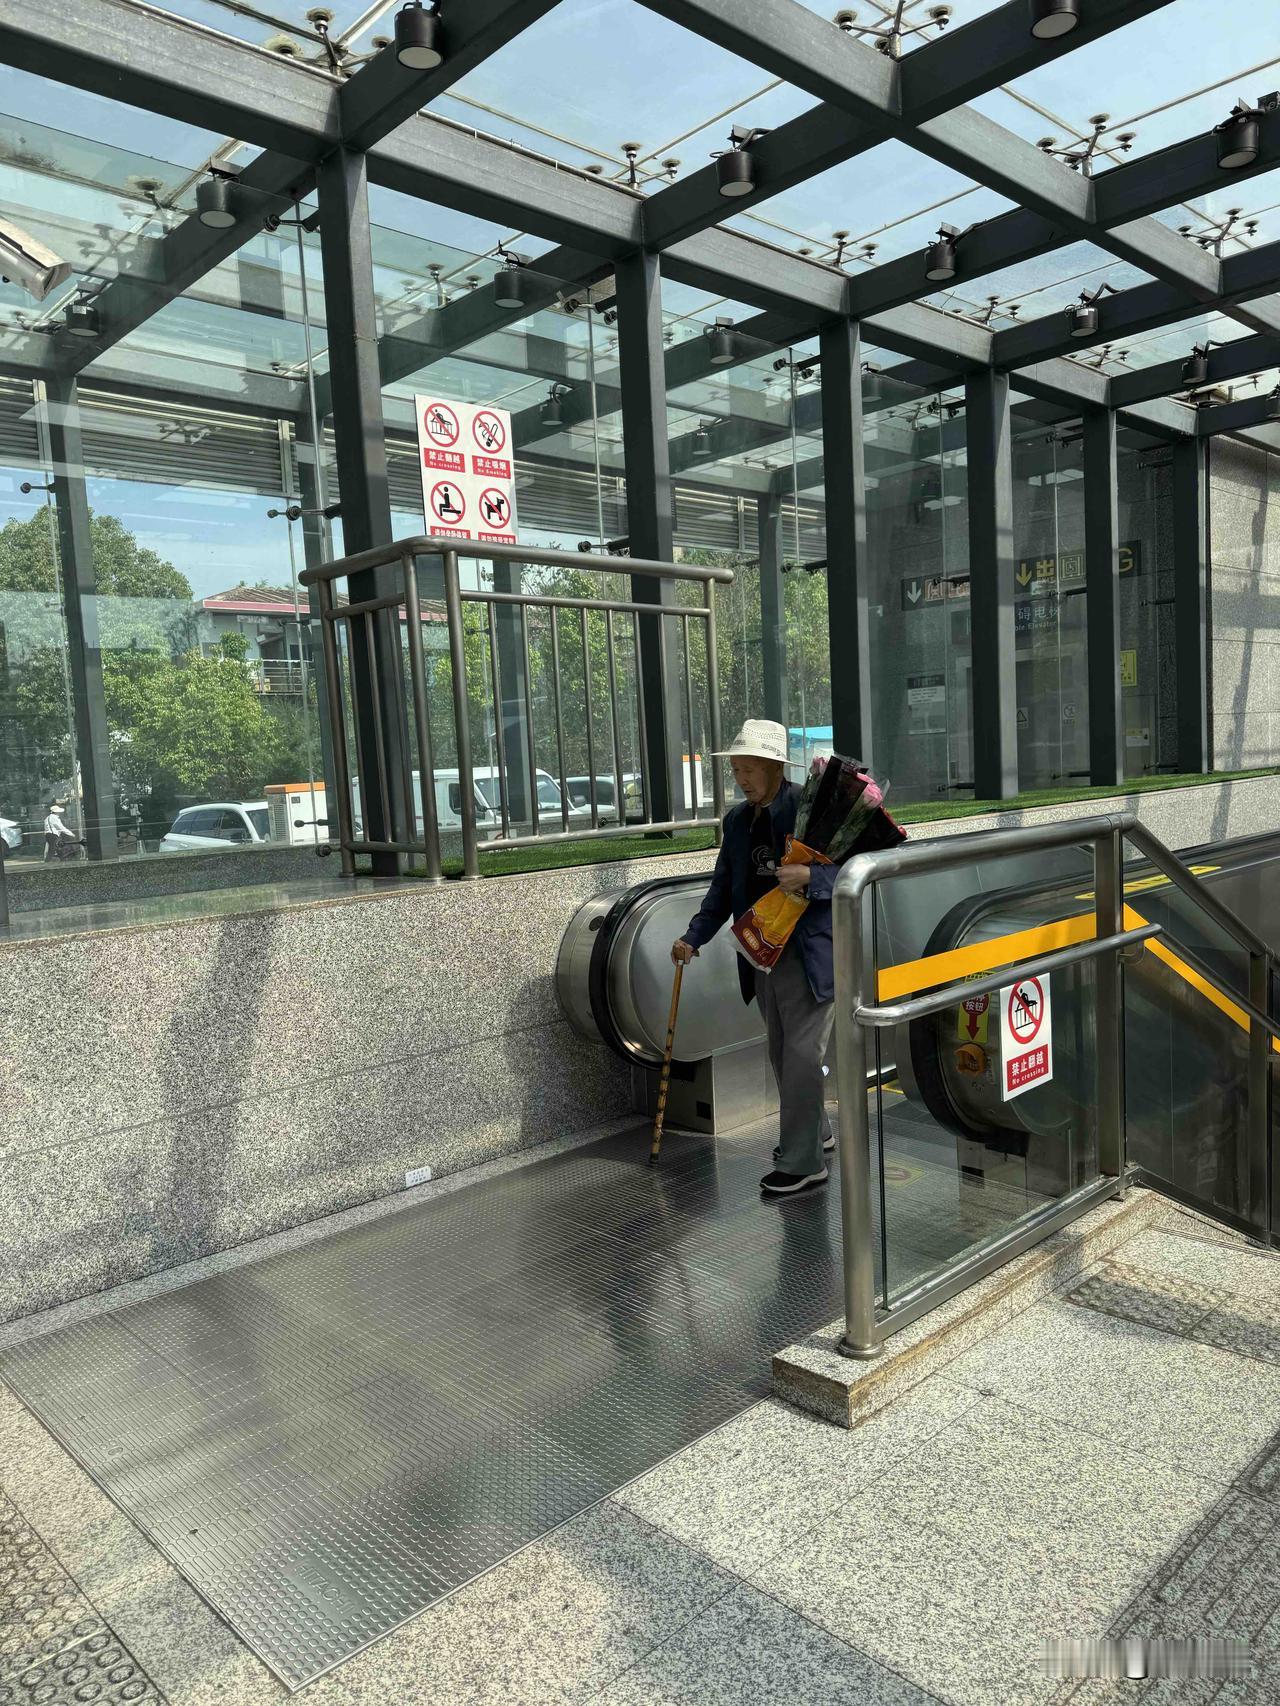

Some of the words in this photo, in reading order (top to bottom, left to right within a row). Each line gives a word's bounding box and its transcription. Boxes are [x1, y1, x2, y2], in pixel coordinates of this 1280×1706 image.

[429, 451, 460, 463] 禁止翻越
[477, 459, 506, 470] 禁止吸烟
[1012, 1051, 1043, 1076] 禁止翻越
[1012, 1078, 1020, 1086] No
[1022, 1068, 1044, 1080] crossing
[294, 1565, 355, 1614] HITACHI
